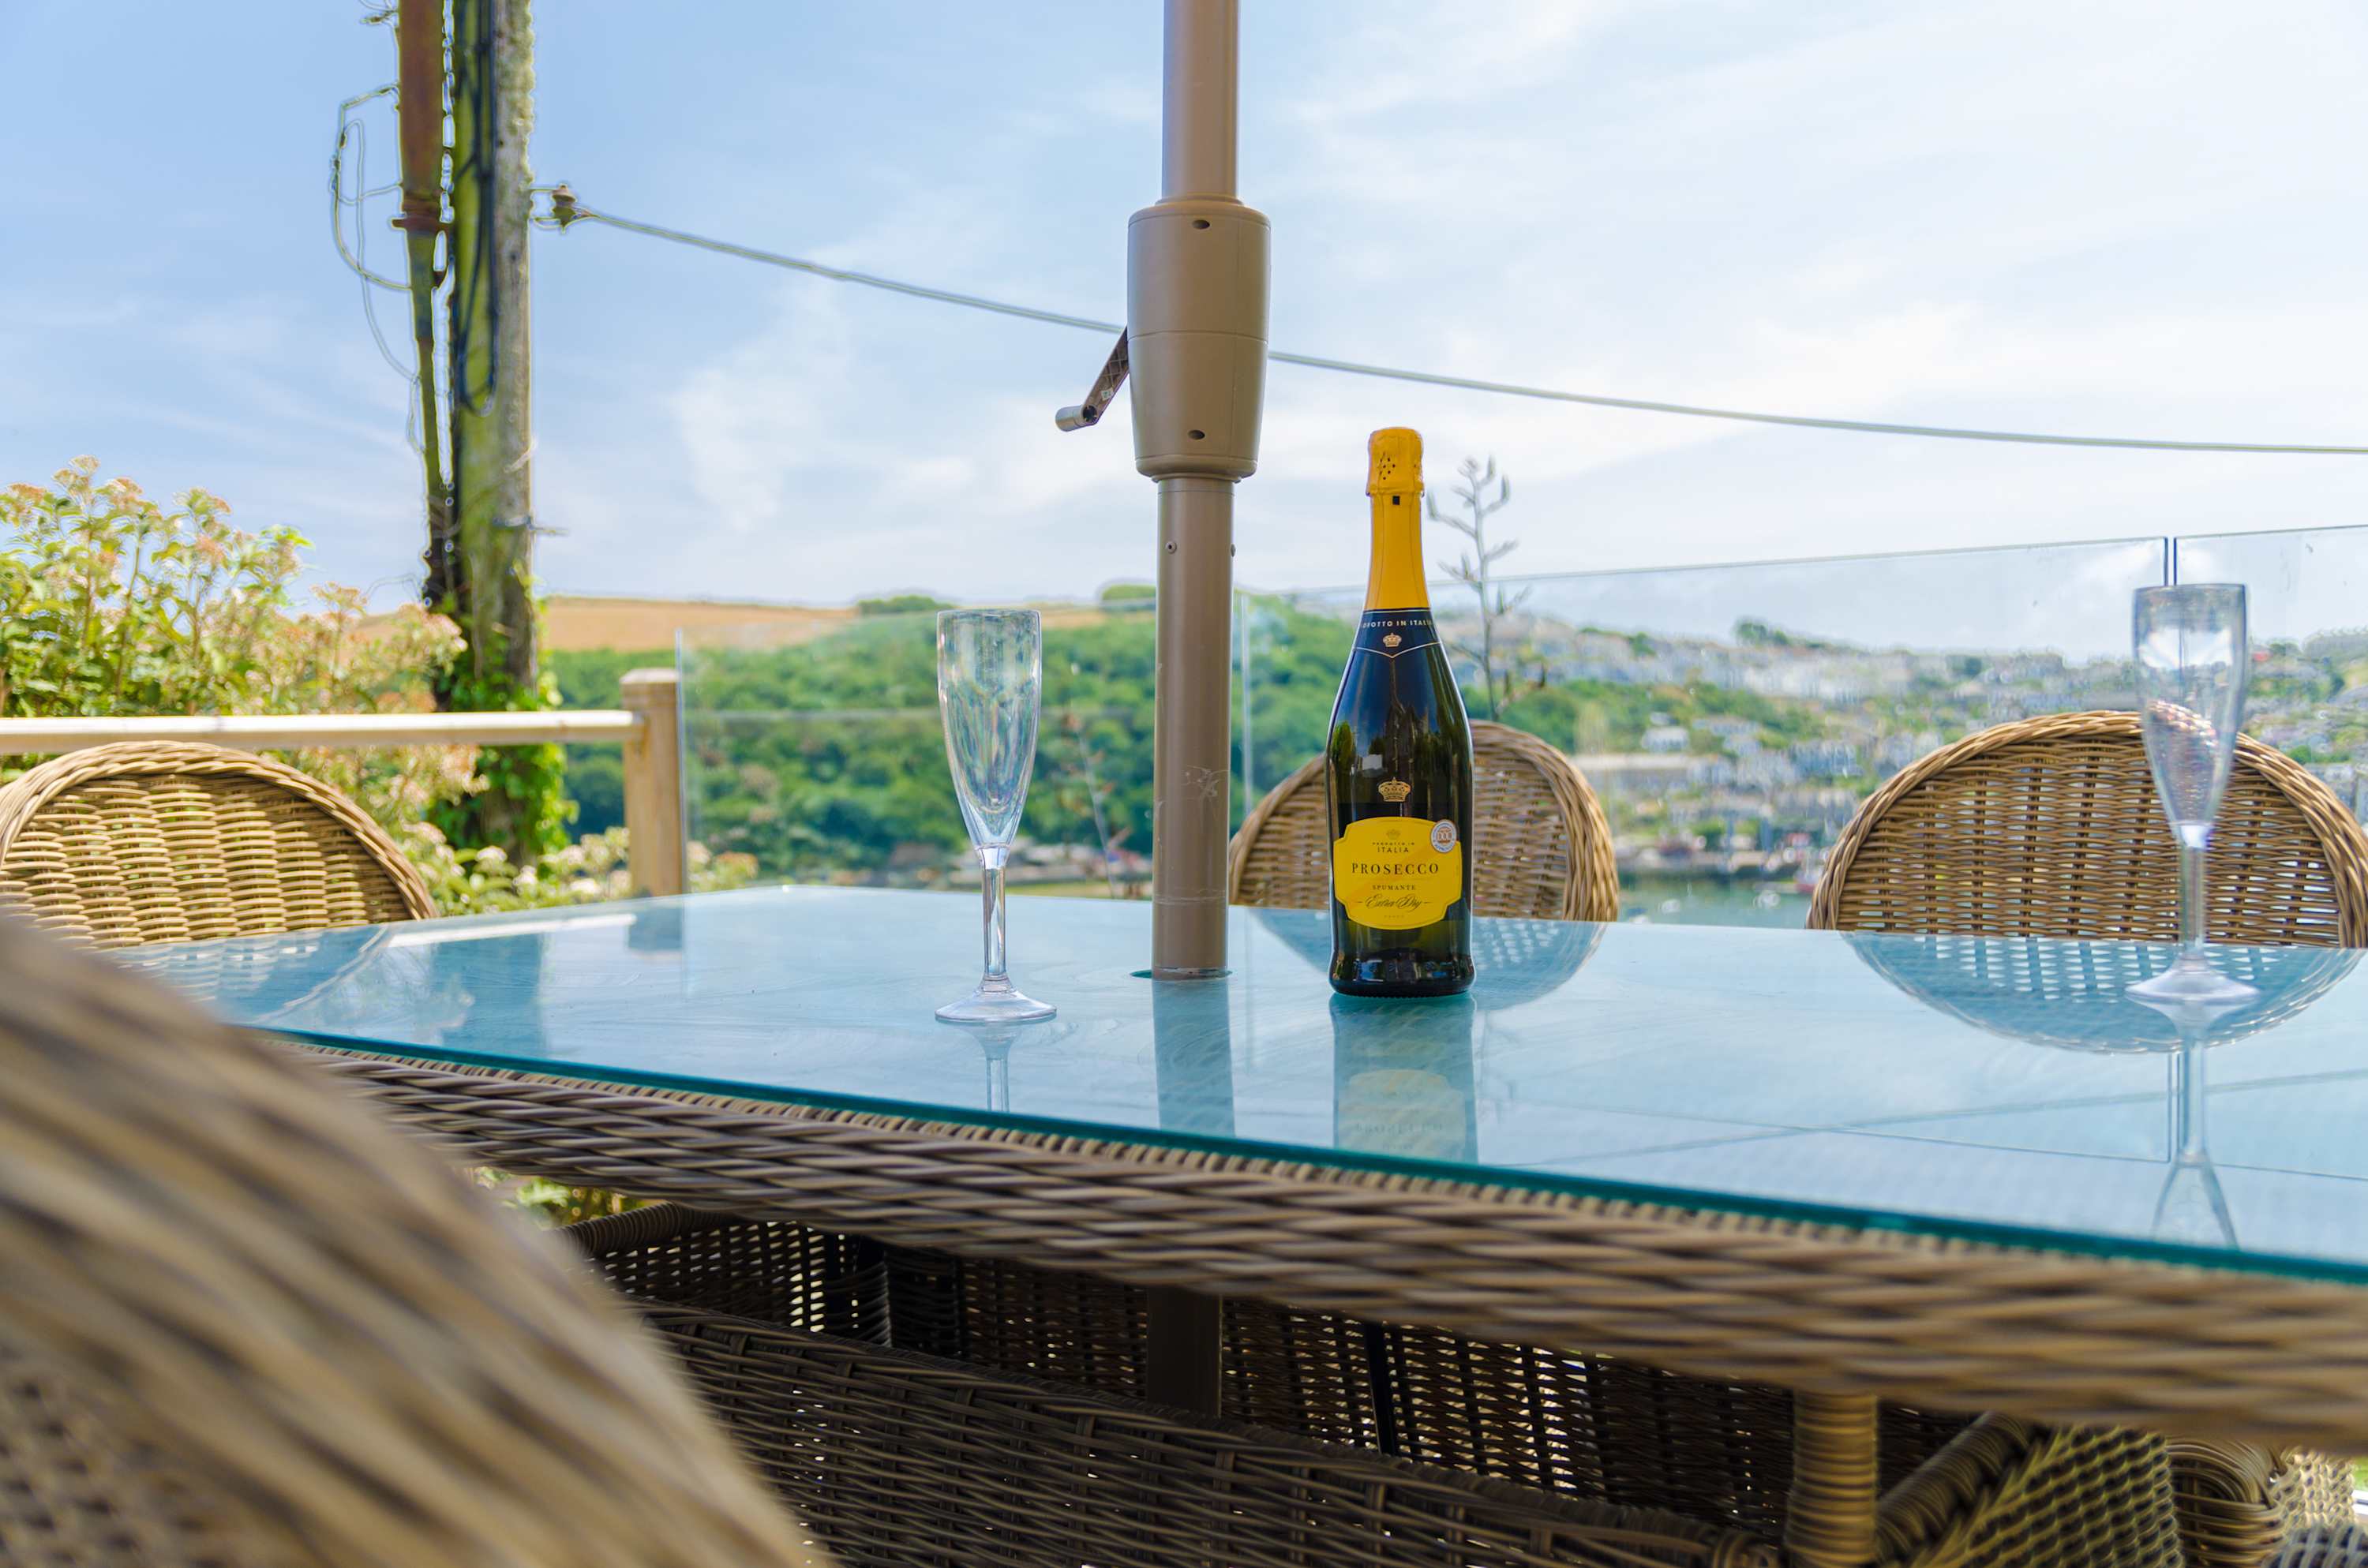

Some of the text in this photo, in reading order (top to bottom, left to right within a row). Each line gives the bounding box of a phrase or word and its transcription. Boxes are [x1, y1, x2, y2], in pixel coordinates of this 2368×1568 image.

[1351, 863, 1439, 875] PROSECCO
[1366, 893, 1422, 912] Extra Dry
